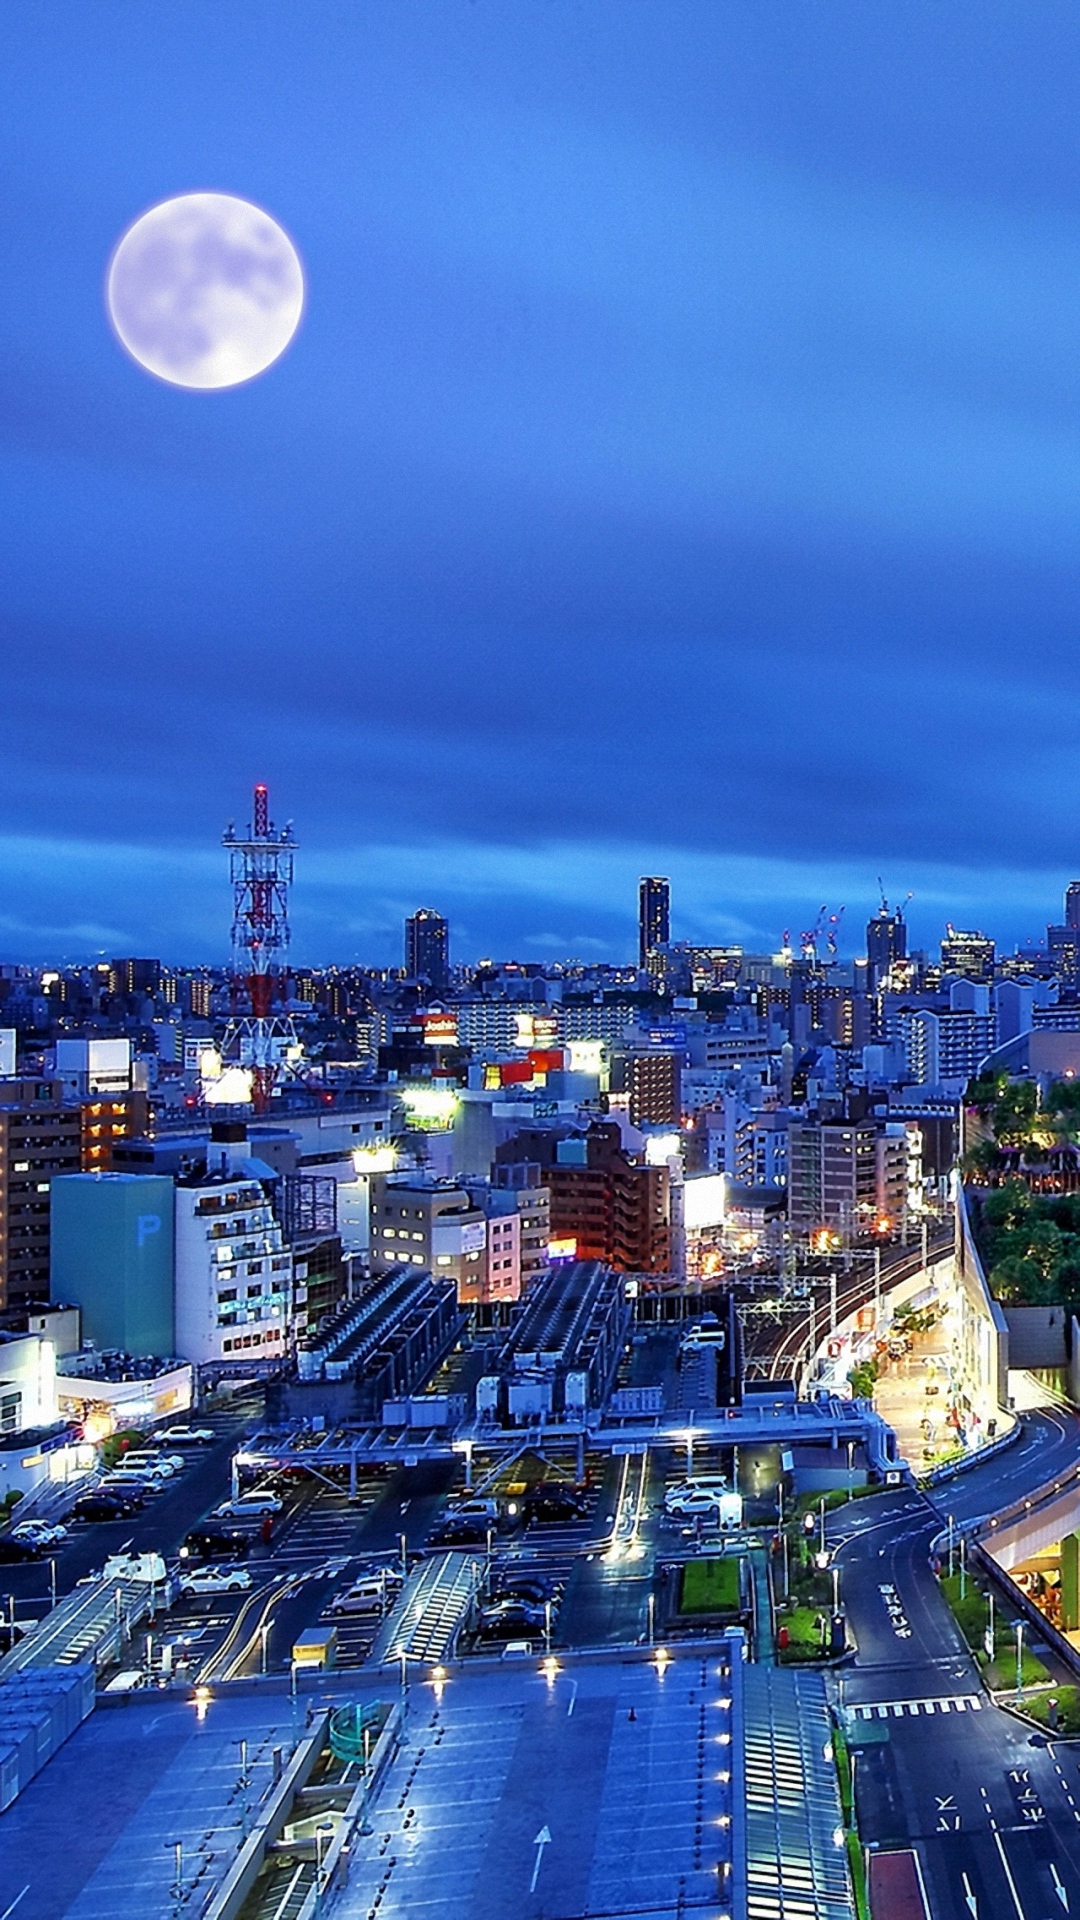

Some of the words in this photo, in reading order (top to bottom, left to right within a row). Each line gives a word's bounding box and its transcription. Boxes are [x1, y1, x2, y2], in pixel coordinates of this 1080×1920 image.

[137, 1215, 161, 1246] P
[935, 1796, 960, 1831] バス
[1009, 1770, 1045, 1822] ホテル
